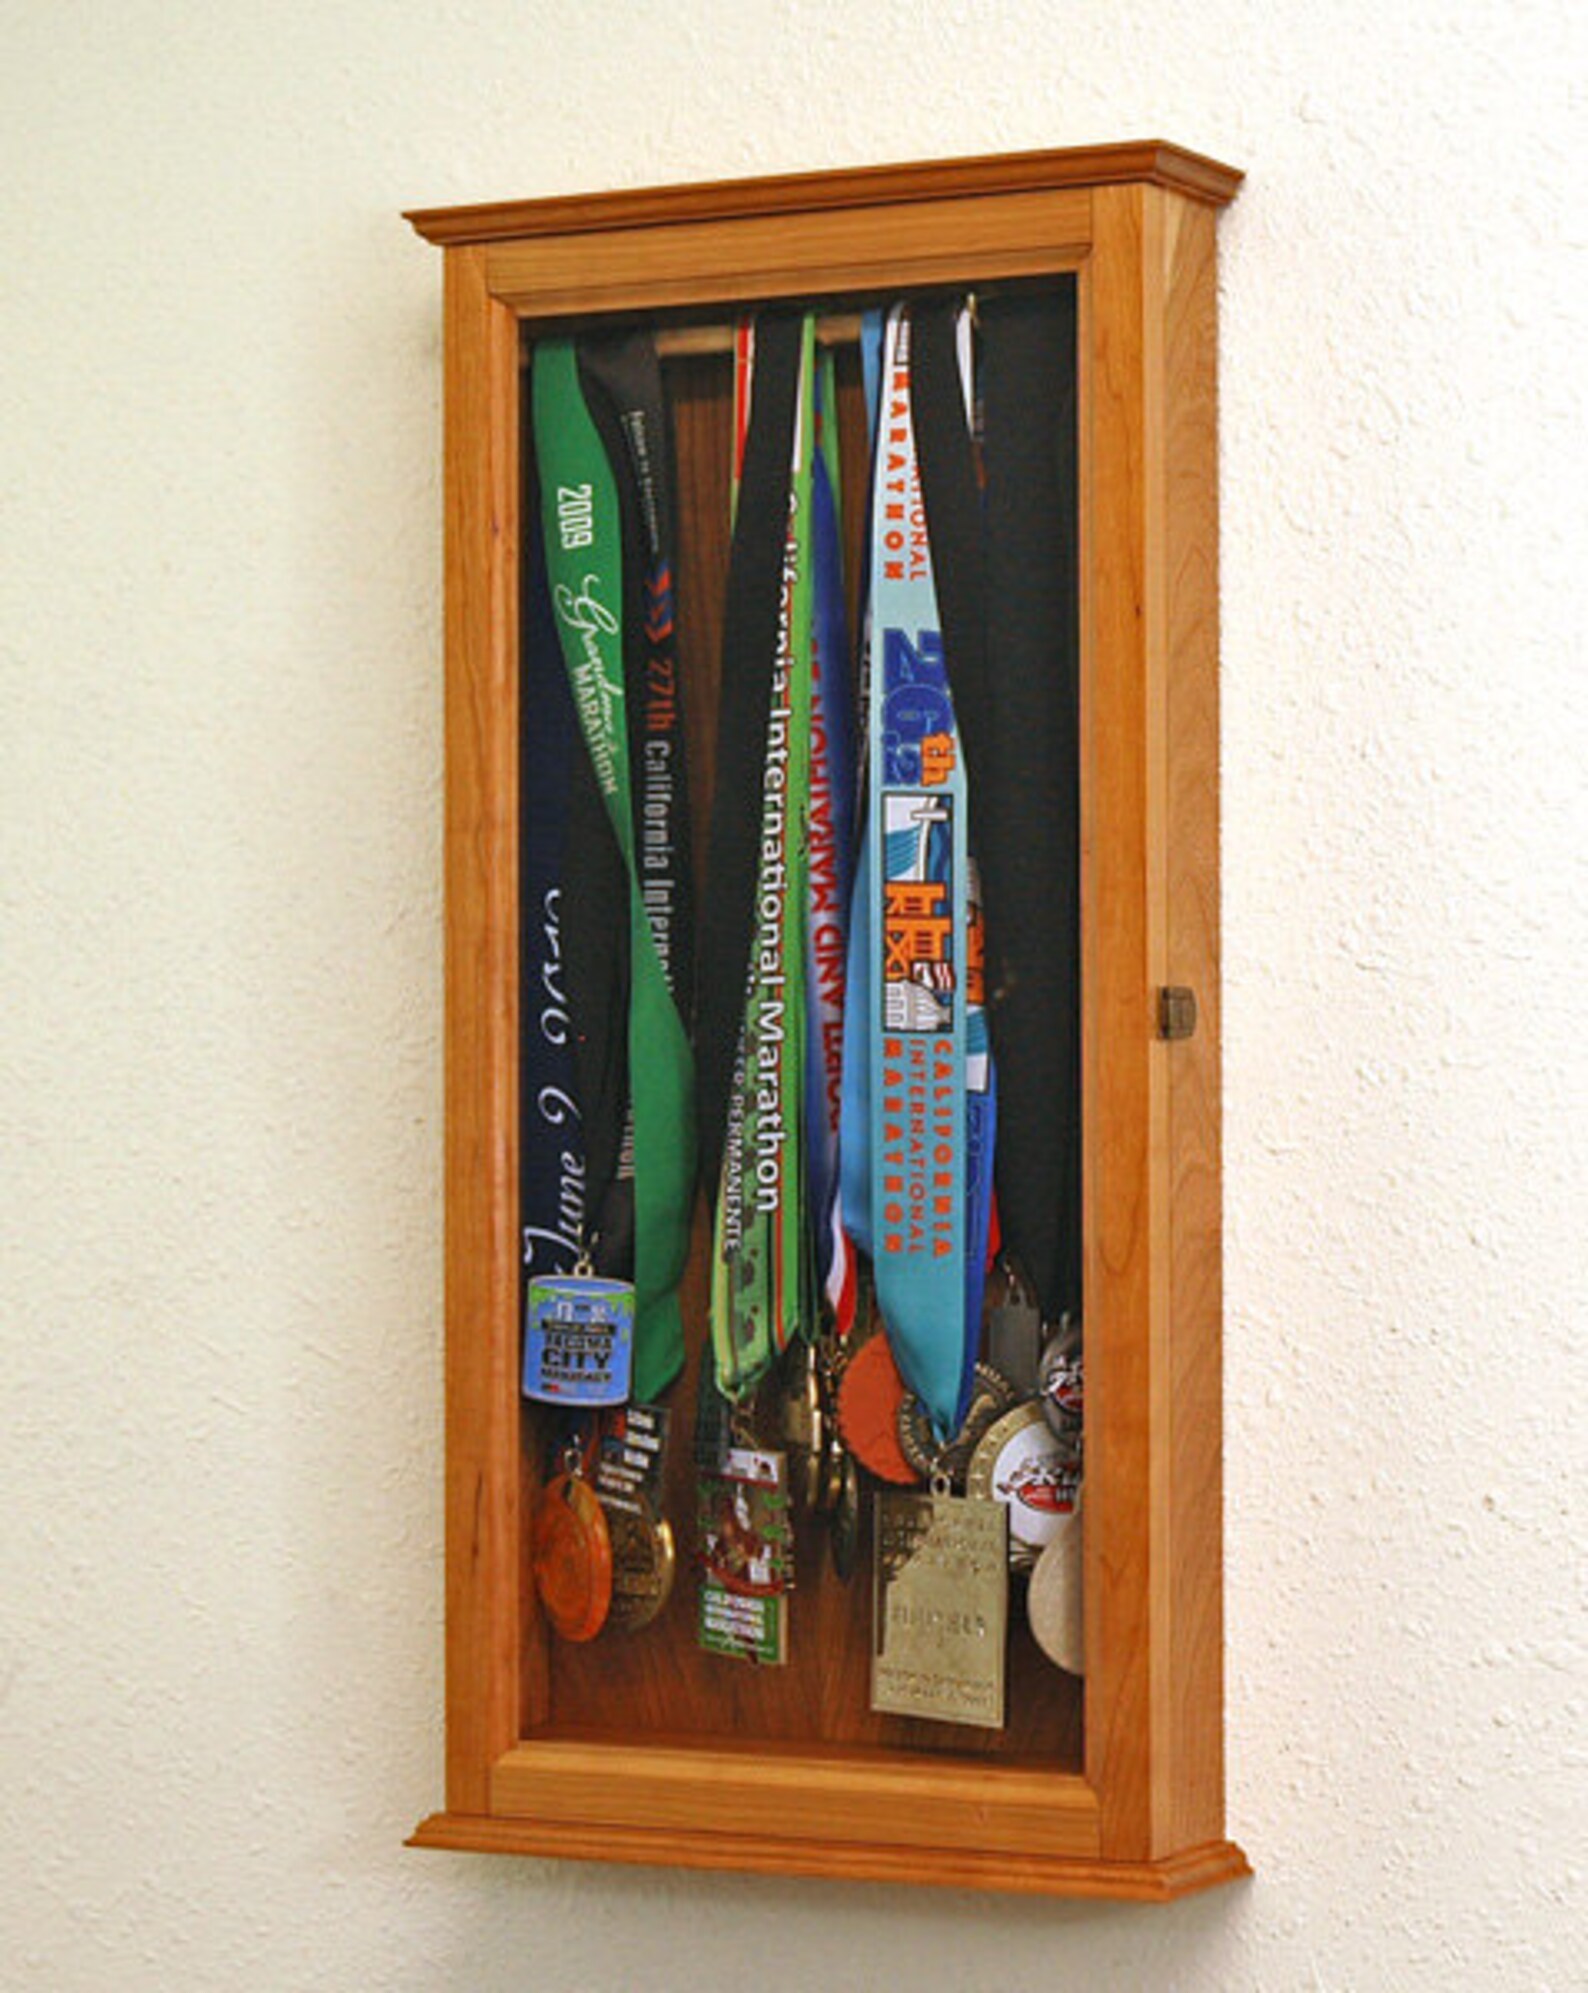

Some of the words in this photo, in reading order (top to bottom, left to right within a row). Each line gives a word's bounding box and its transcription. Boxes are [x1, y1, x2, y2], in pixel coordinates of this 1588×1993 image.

[556, 483, 593, 550] 2009
[884, 371, 910, 581] MARATHON
[570, 662, 619, 796] MARATHON
[645, 657, 677, 730] 27th
[643, 739, 674, 870] California
[758, 708, 794, 987] International
[755, 1000, 788, 1212] Marathon
[883, 1036, 903, 1256] MARATHON
[908, 1038, 926, 1255] INTERNATIONAL
[930, 1037, 954, 1260] CALIFORNIA
